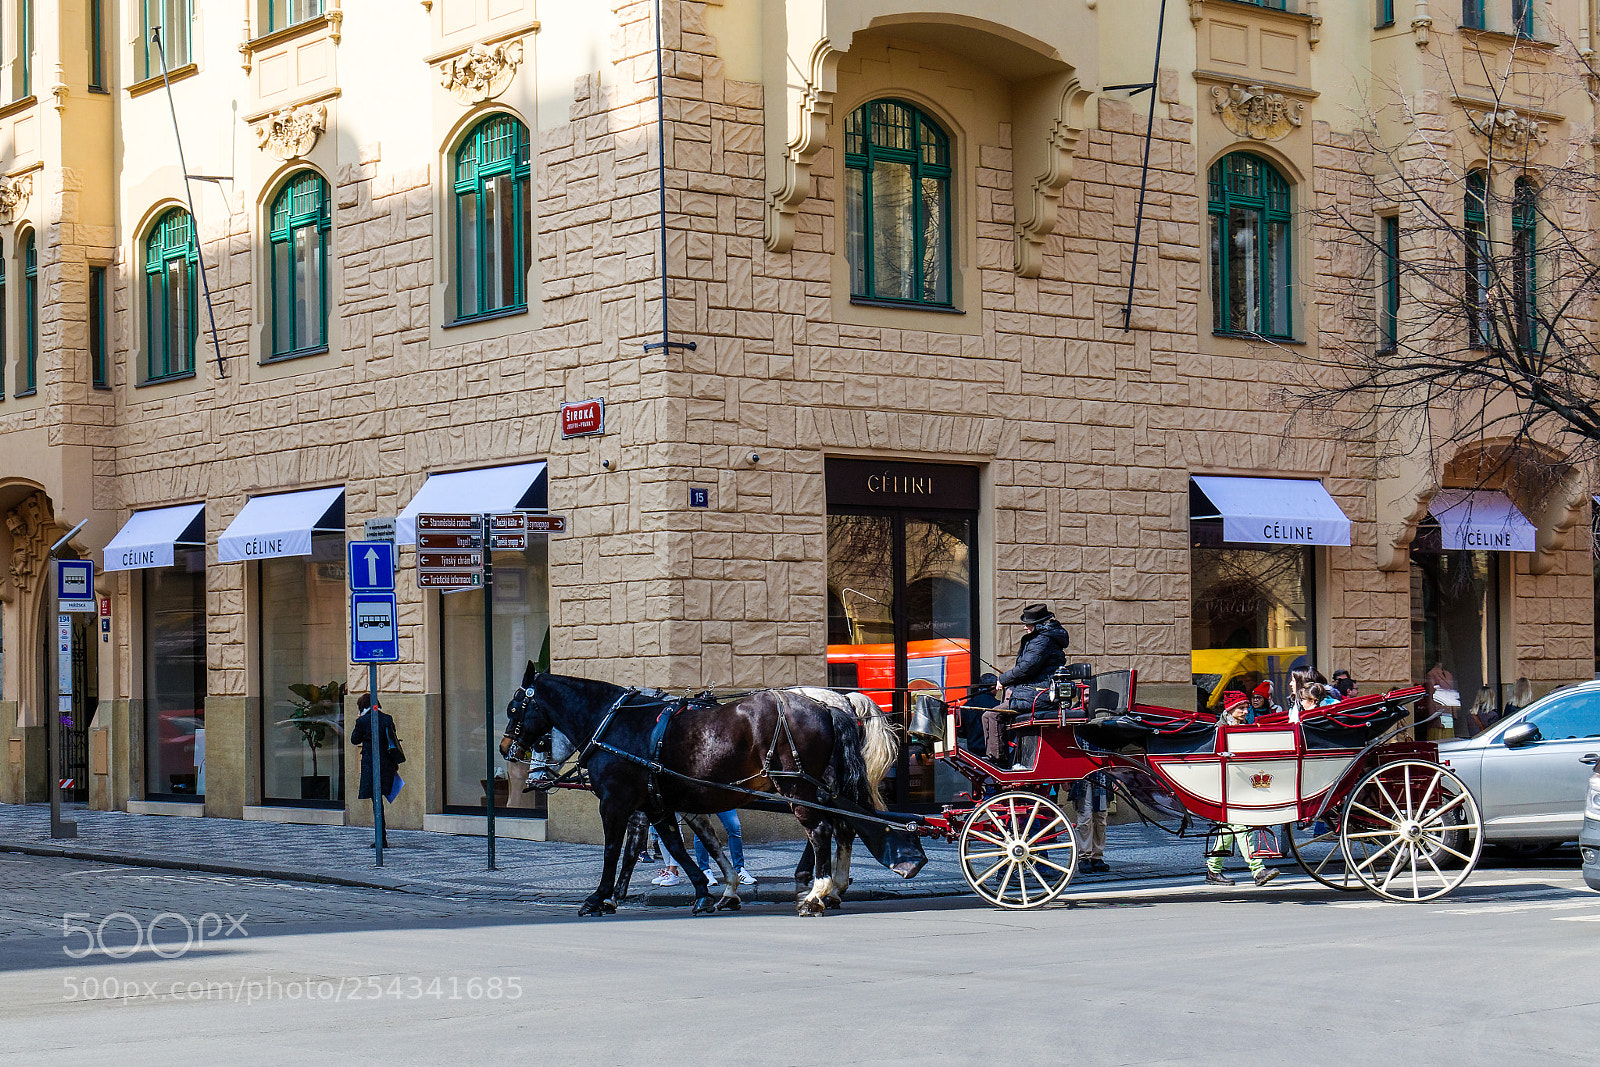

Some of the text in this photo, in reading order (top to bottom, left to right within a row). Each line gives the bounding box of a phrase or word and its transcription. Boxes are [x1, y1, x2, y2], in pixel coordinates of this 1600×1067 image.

[566, 406, 594, 422] ŠIROKÁ
[695, 492, 704, 503] 15
[1263, 521, 1314, 540] CÉLINE
[1467, 529, 1512, 546] CÉLINE
[245, 538, 282, 555] CÉLINE
[122, 550, 154, 566] CÉLINE
[441, 555, 456, 567] Týnský
